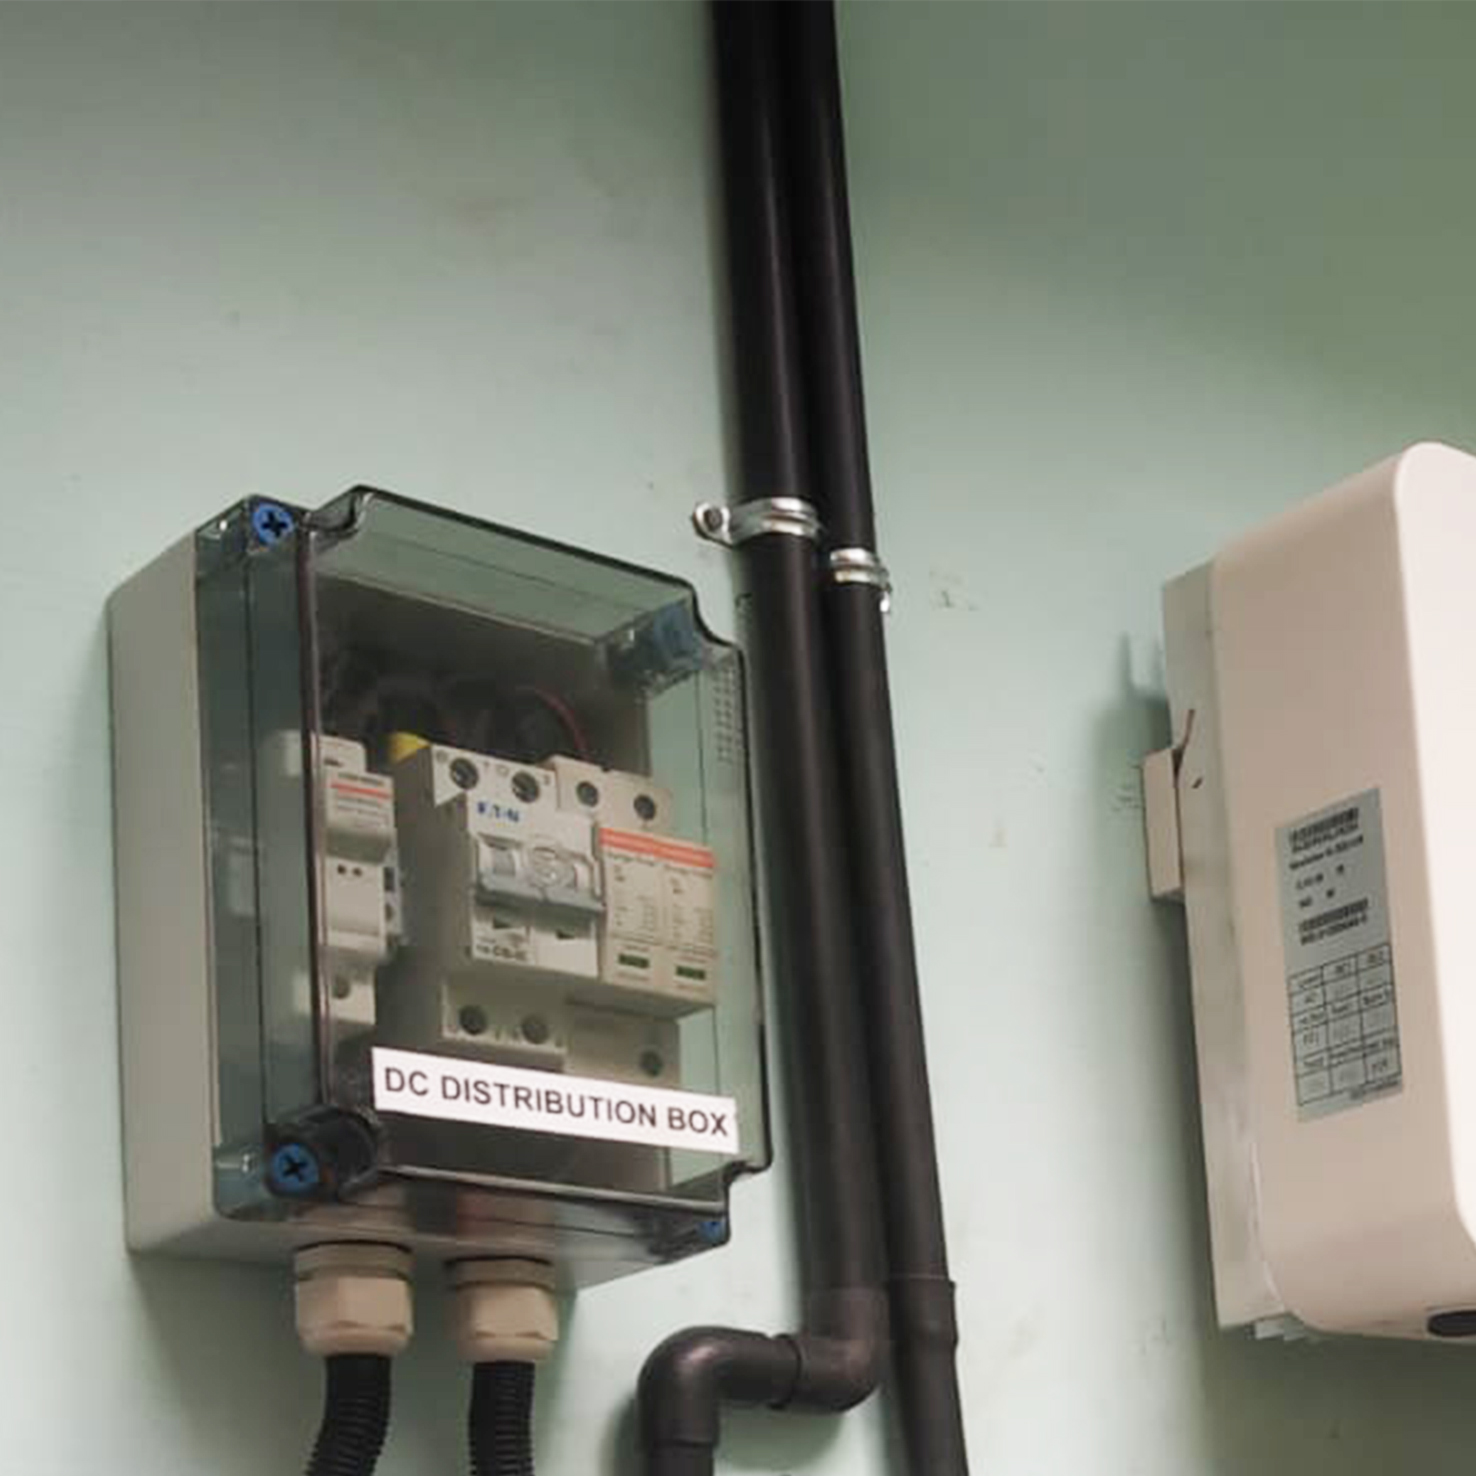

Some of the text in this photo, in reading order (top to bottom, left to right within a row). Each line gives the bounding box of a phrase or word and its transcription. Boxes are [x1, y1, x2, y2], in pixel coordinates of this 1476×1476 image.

[384, 1066, 730, 1137] DC DISTRIBUTION BOX
